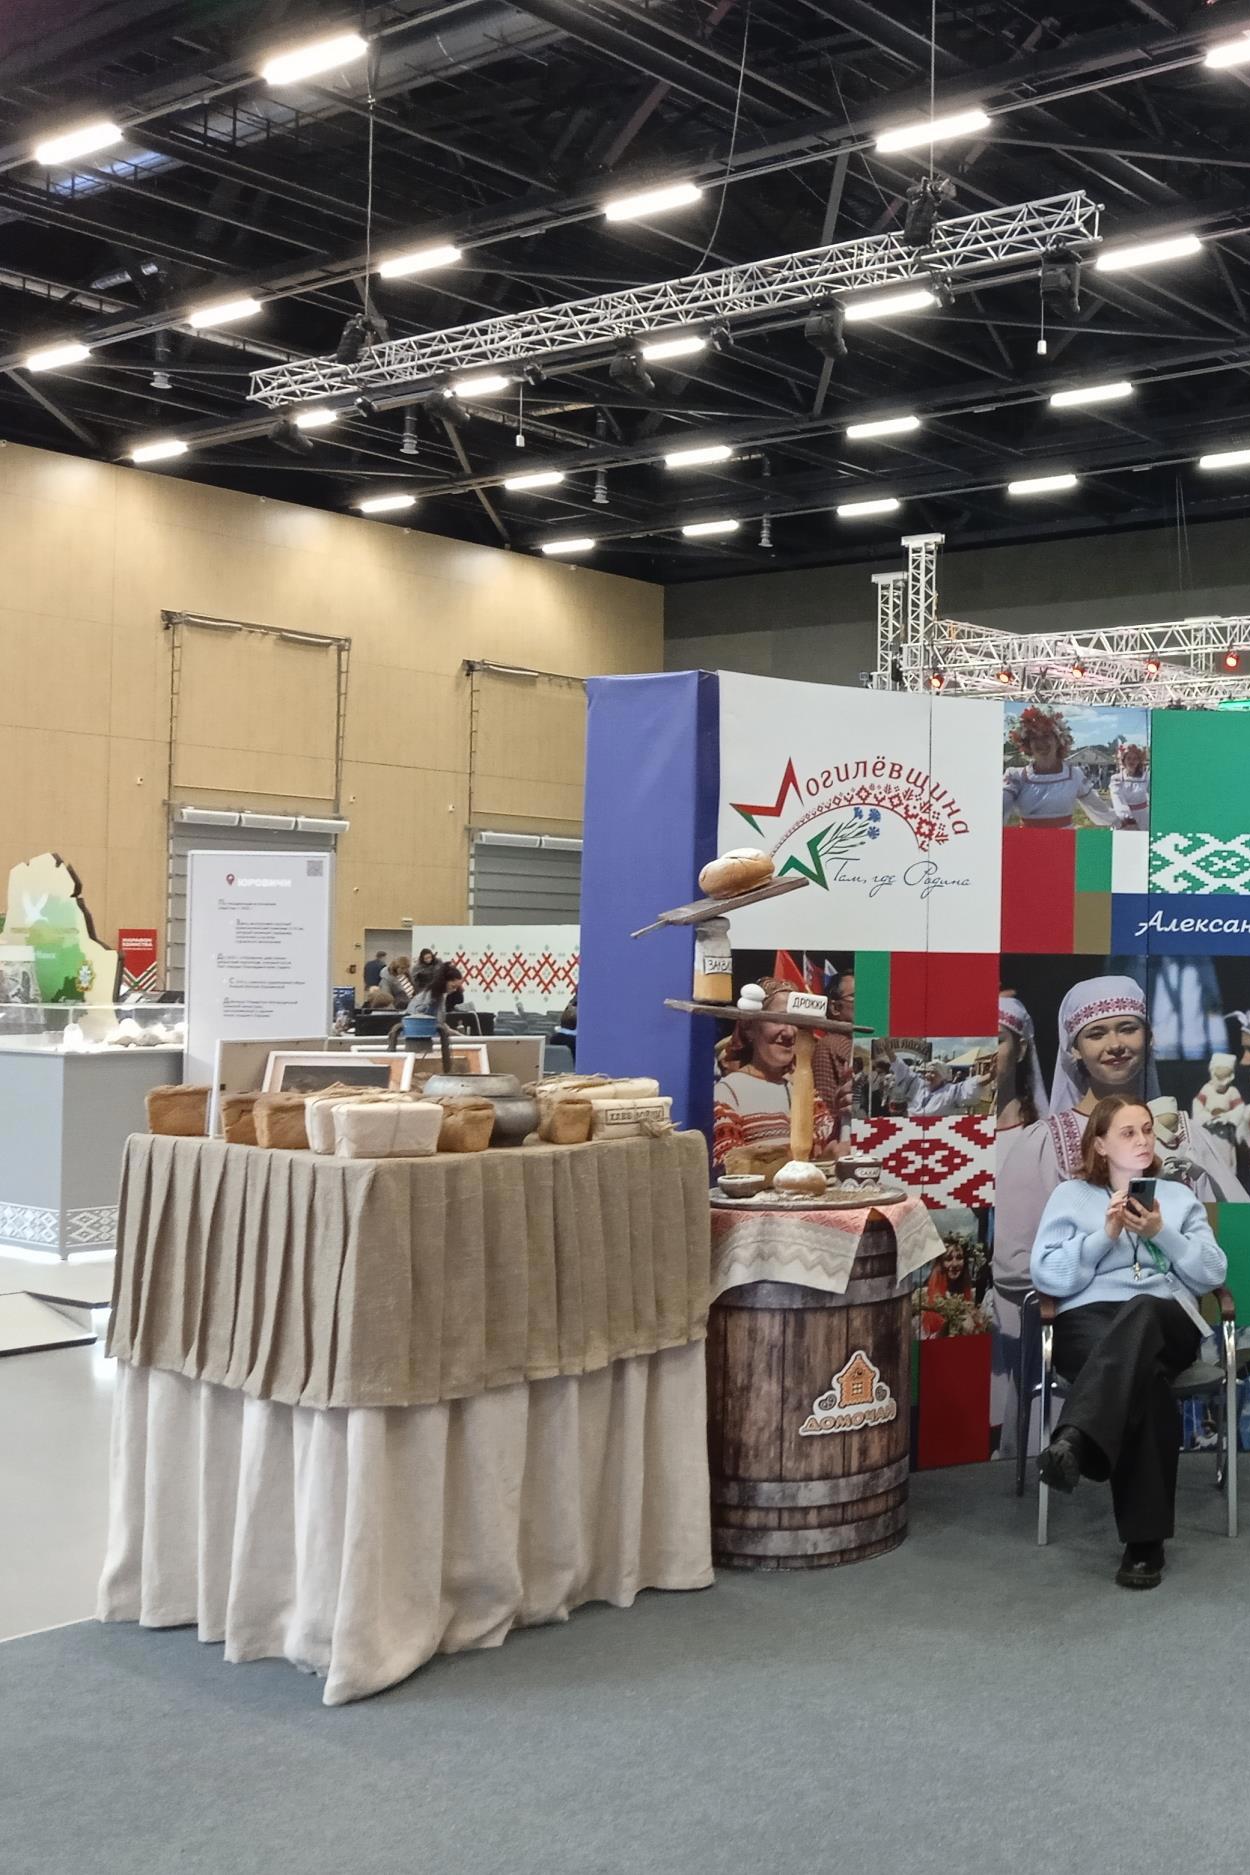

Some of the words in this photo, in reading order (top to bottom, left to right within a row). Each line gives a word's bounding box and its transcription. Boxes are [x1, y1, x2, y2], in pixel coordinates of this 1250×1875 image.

[825, 857, 867, 883] Там,
[903, 860, 972, 899] Родина
[801, 1402, 896, 1433] ДОМОЧАЙ
